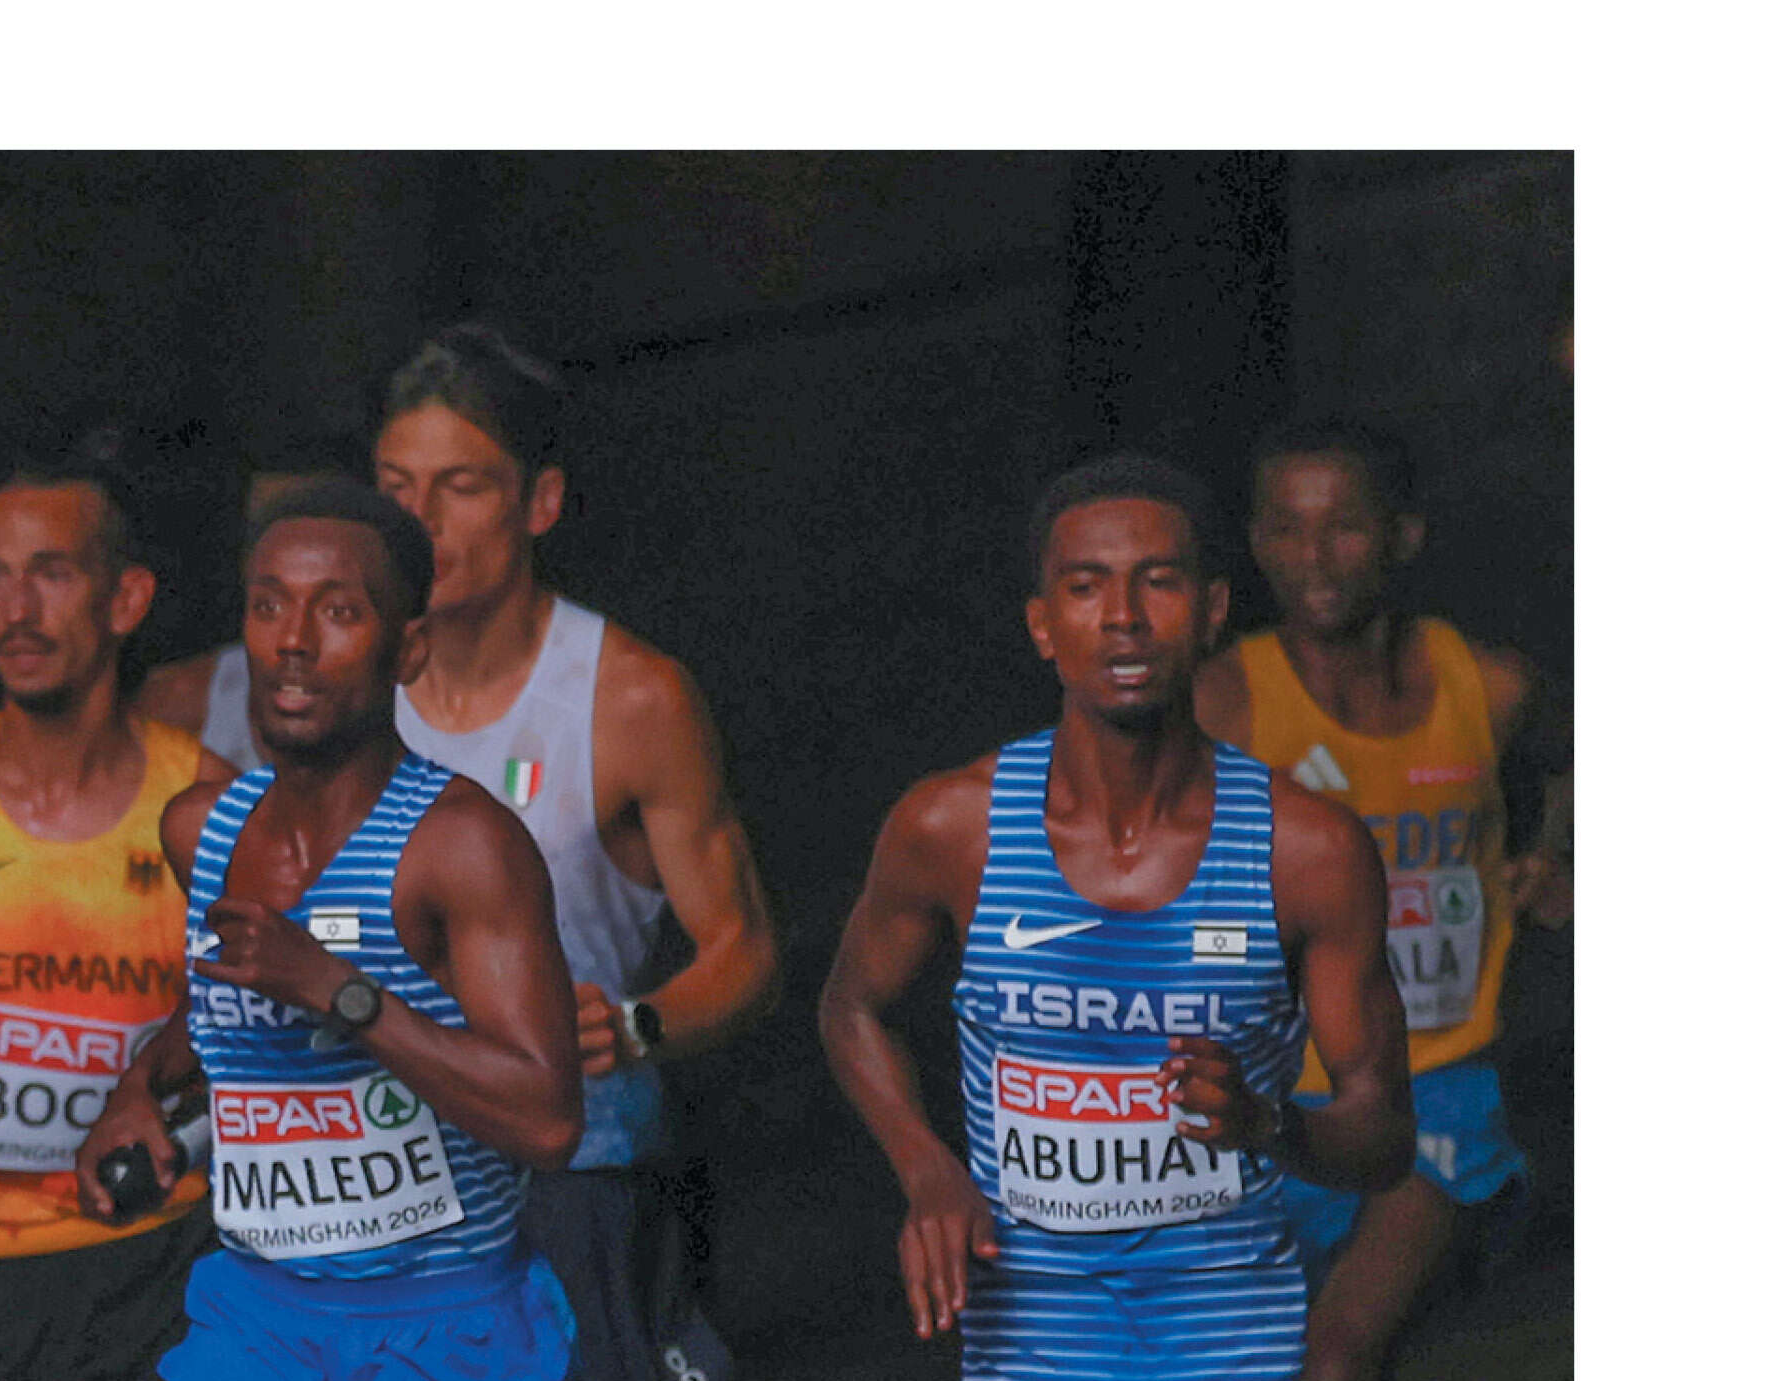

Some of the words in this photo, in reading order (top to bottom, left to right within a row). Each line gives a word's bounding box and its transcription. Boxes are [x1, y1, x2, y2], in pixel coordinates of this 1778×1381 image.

[997, 981, 1233, 1034] ISRAEL
[1000, 1067, 1169, 1117] SPAR
[218, 1096, 361, 1138] SPAR
[221, 1135, 441, 1212] MALEDE
[387, 1195, 448, 1232] 2026
[1170, 1188, 1230, 1213] 2026
